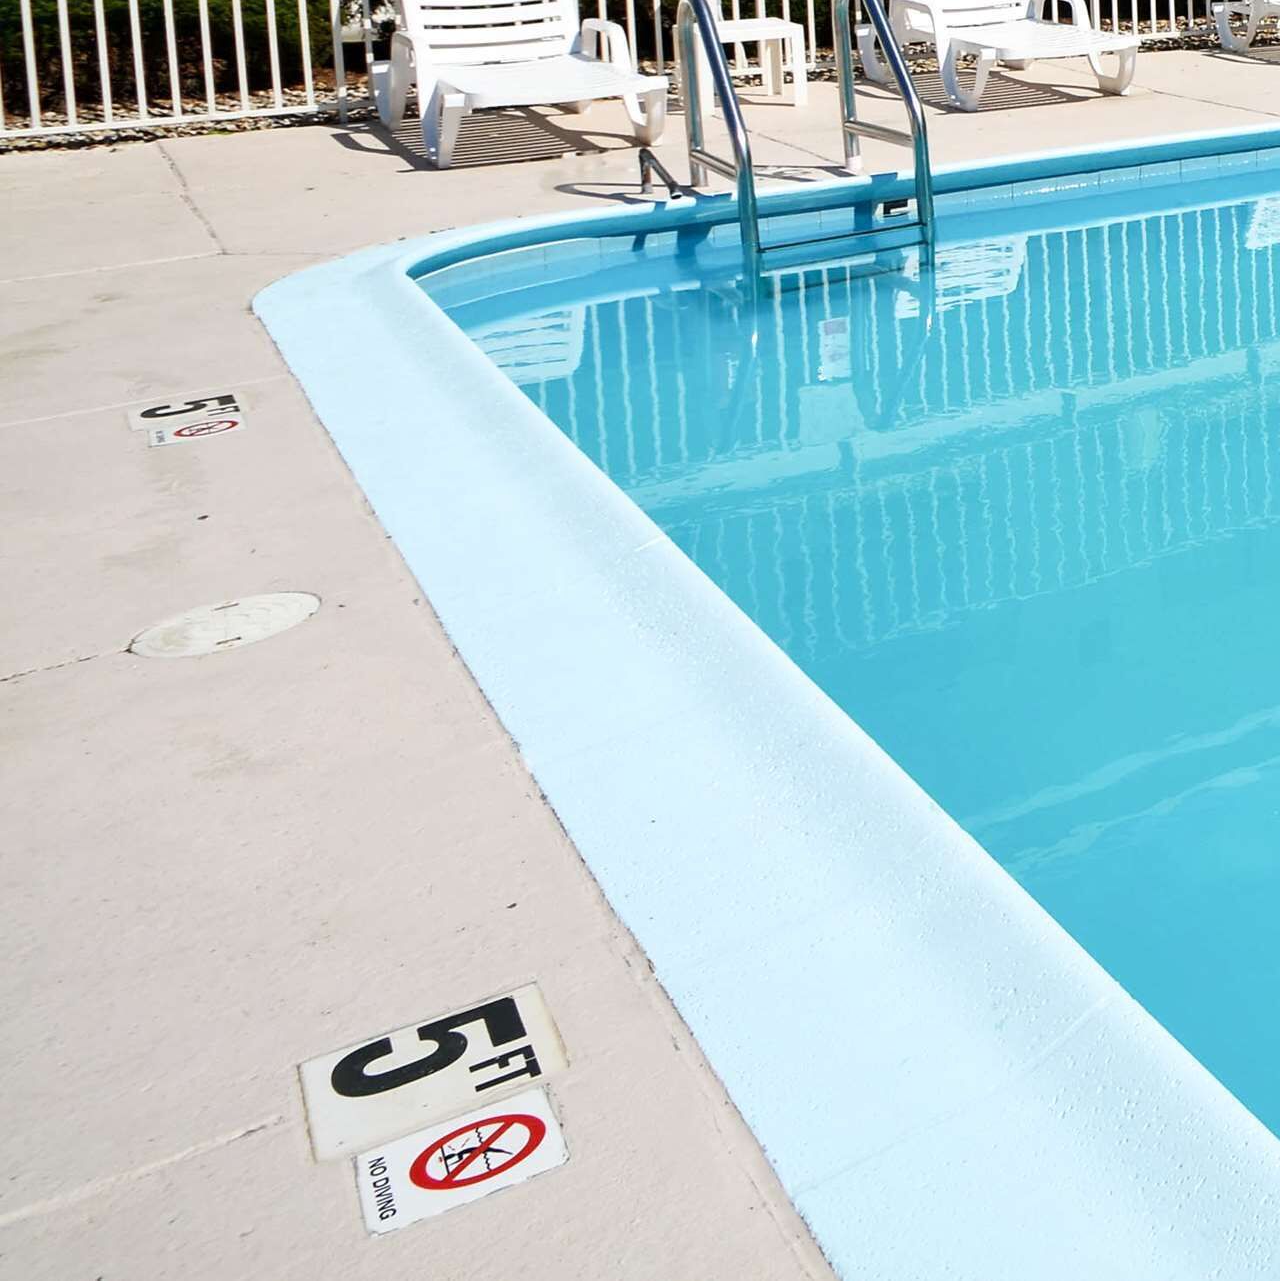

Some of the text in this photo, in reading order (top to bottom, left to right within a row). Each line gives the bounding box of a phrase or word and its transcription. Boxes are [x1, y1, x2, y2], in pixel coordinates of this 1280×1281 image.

[140, 394, 237, 418] 5
[330, 996, 543, 1098] 5 FT
[368, 1156, 397, 1221] NO DIVING
